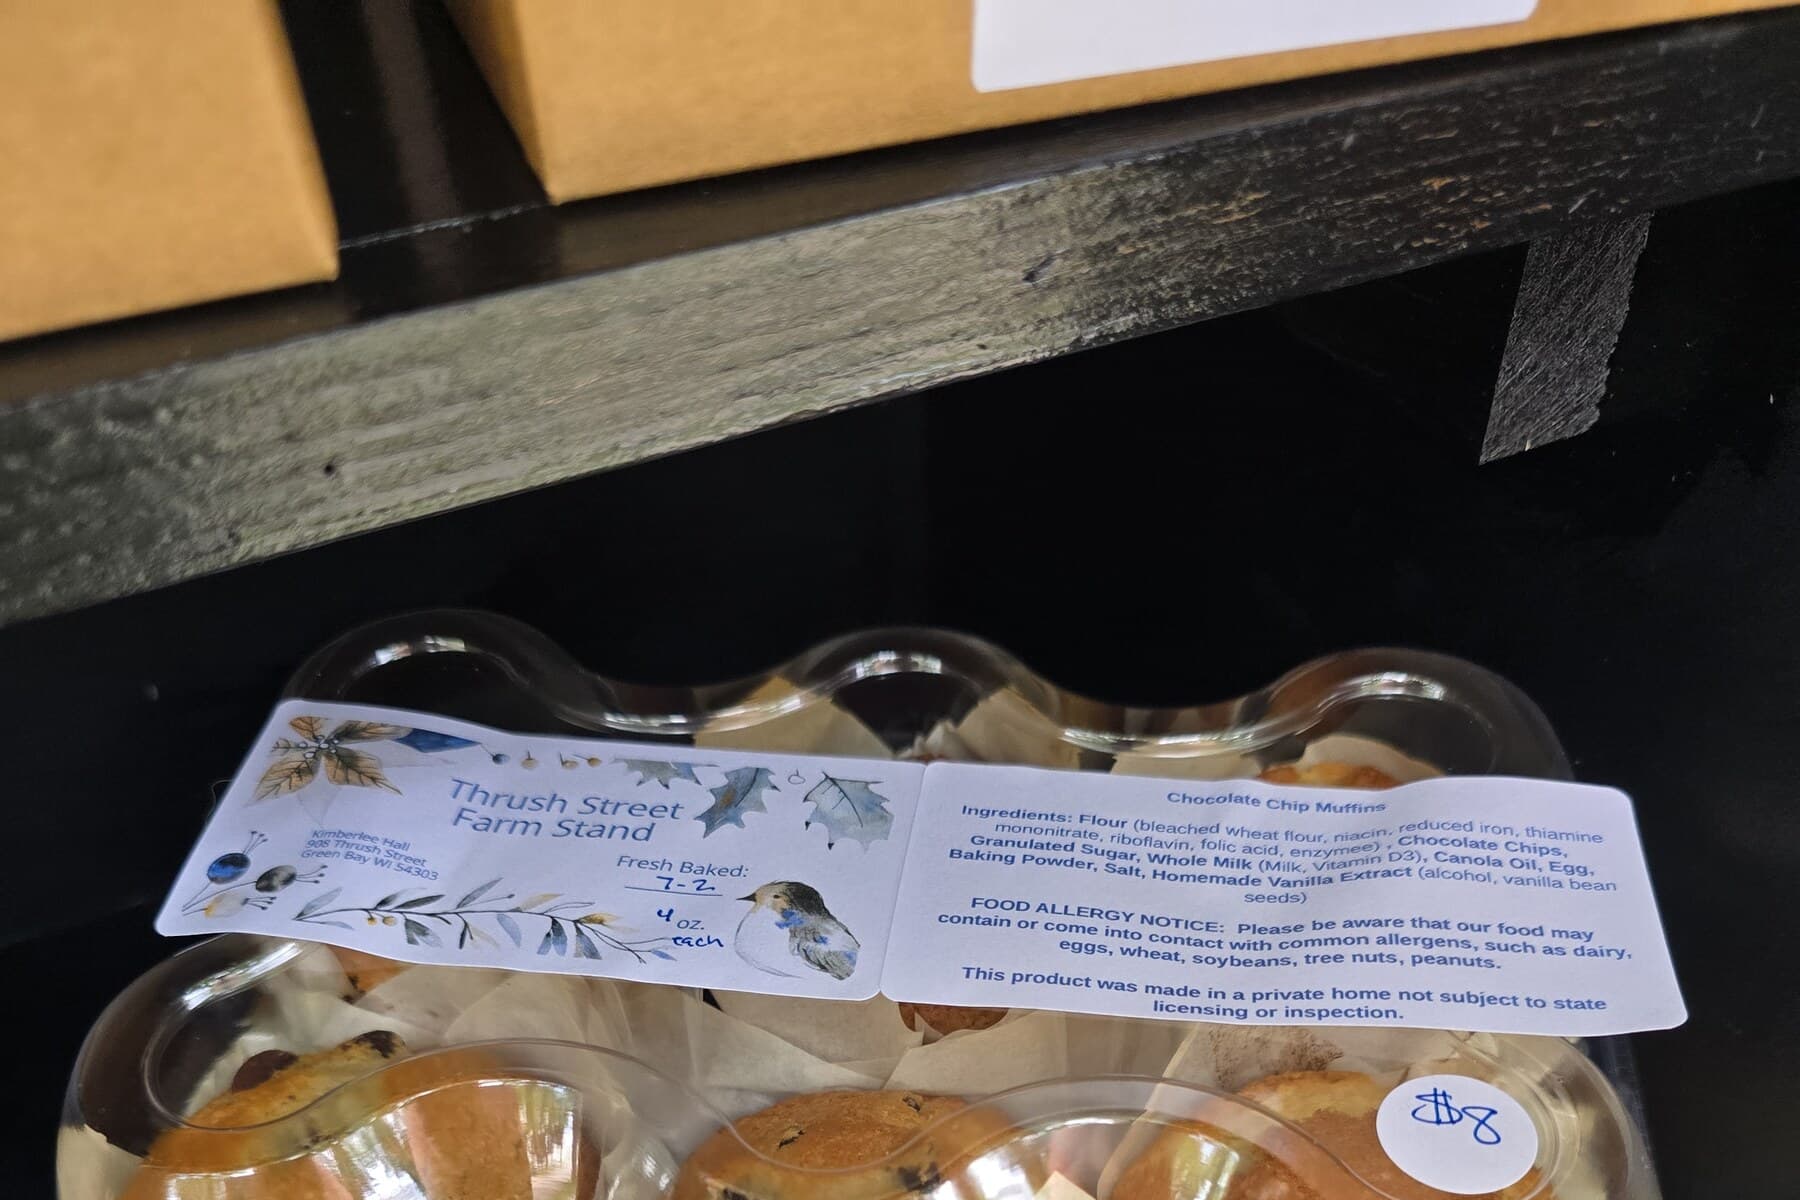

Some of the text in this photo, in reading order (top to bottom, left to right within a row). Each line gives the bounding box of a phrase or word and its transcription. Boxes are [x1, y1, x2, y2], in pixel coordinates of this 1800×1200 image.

[451, 778, 683, 820] Thrush Street
[1167, 792, 1387, 814] Chocolate Chip Muffins
[312, 829, 411, 851] Kimberlee Hall
[452, 807, 656, 842] Farm Stand
[961, 804, 1604, 844] Ingredients: Flour (bleached wheat flour, niacin, reduced iron, thiamine
[334, 839, 381, 855] Thrush
[384, 849, 427, 867] Street
[970, 835, 1595, 877] Granulated Sugar, Whole Milk (Milk, Vitamin D3), Canola Oil, Egg,
[995, 823, 1102, 842] mononitrate,
[1110, 832, 1195, 852] riboflavin,
[1200, 838, 1236, 853] folic
[1241, 843, 1284, 858] acid,
[1398, 836, 1498, 852] Chocolate
[1505, 841, 1568, 859] Chips,
[301, 849, 439, 881] Green Bay WI 54303
[616, 855, 749, 878] Fresh Baked:
[949, 848, 1617, 892] Baking Powder, Salt, Homemade Vanilla Extract (alcohol, vanilla bean
[656, 876, 716, 891] 7-2
[1244, 891, 1307, 904] seeds)
[657, 908, 705, 930] 4 oz.
[971, 897, 1594, 943] FOOD ALLERGY NOTICE: Please be aware that our food may
[672, 935, 724, 947] each
[938, 912, 1633, 960] contain or come into contact with common allergens, such as dairy,
[1059, 938, 1502, 969] eggs, wheat, soybeans, tree nuts, peanuts.
[962, 966, 1607, 1011] This product was made in a private home not subject to state
[1153, 1000, 1404, 1021] licensing or inspection.
[1410, 1086, 1502, 1146] $8
